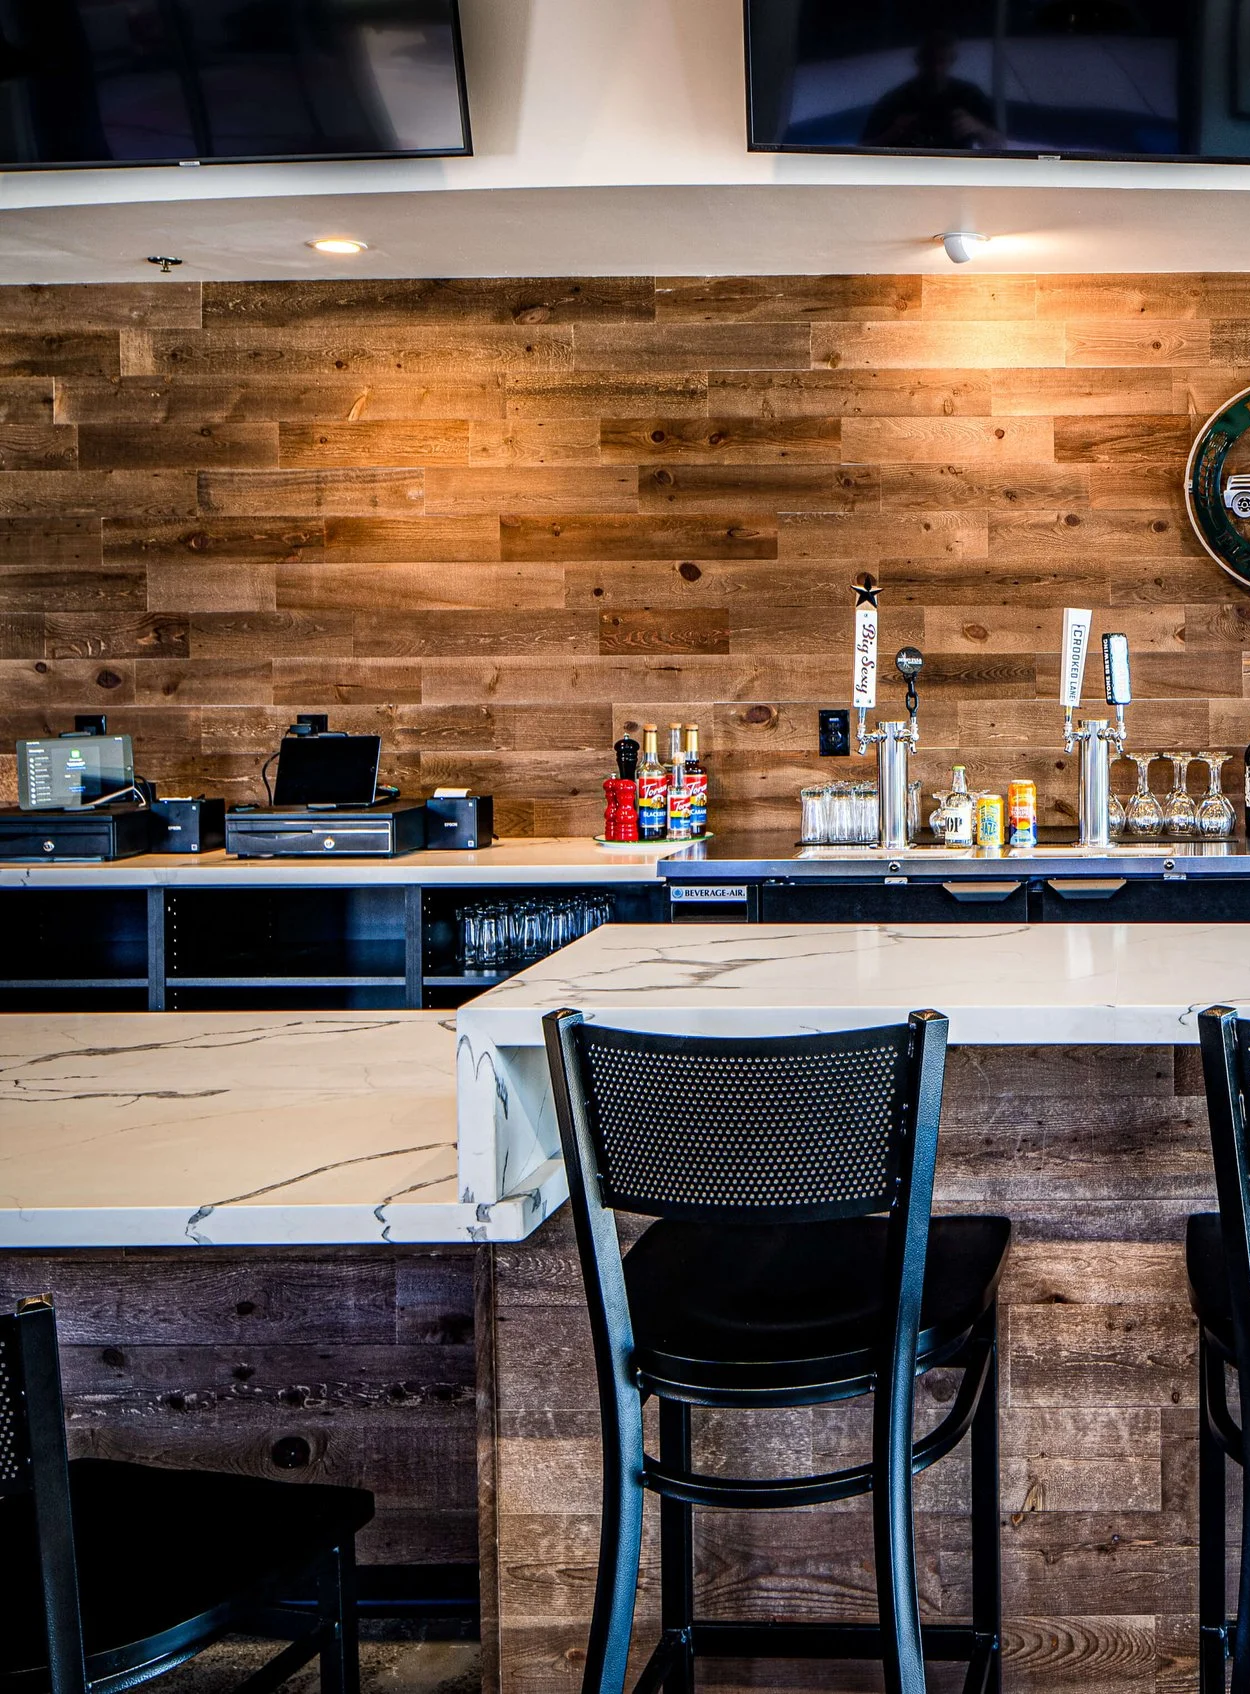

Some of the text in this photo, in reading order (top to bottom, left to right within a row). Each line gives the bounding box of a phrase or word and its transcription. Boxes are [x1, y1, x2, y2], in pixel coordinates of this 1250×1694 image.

[855, 624, 876, 694] Big Sexy
[1069, 629, 1083, 699] CROOKED LANE
[1102, 639, 1110, 675] BREWING
